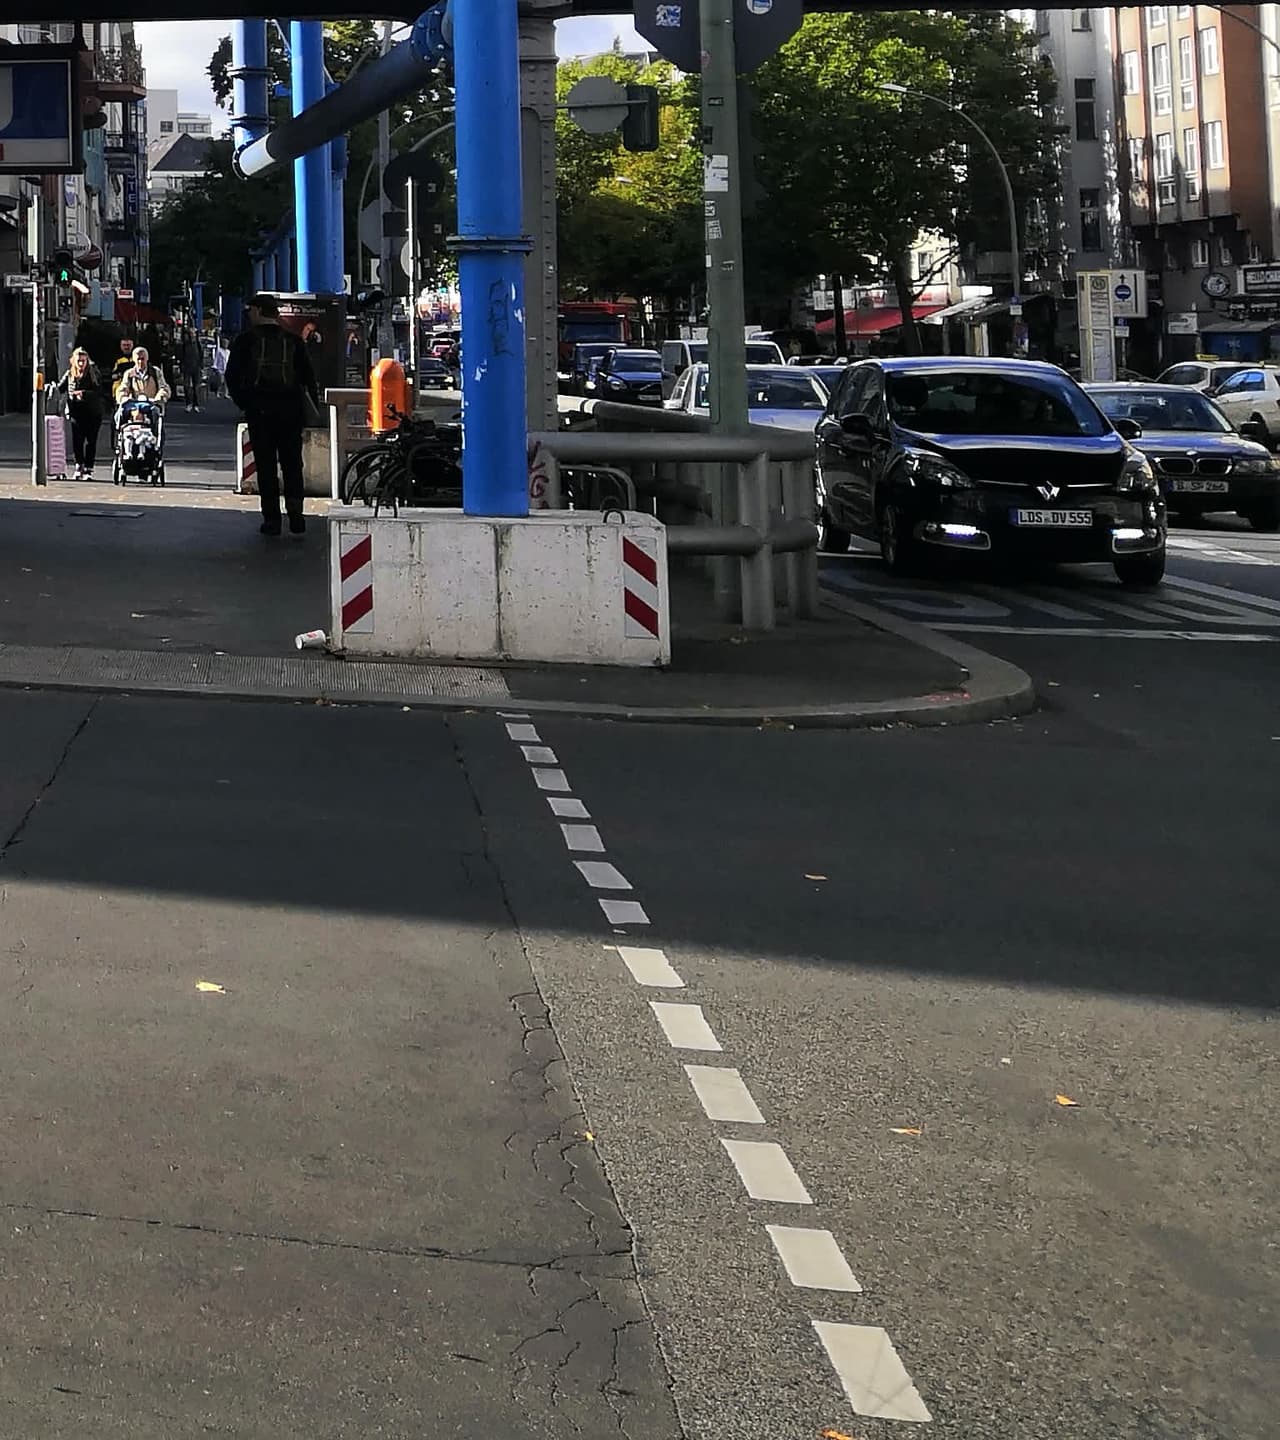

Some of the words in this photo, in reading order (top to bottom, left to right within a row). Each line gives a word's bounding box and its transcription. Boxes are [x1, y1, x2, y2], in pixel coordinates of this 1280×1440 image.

[1019, 511, 1043, 524] LDS
[1051, 511, 1068, 524] DV
[1069, 511, 1092, 525] 555
